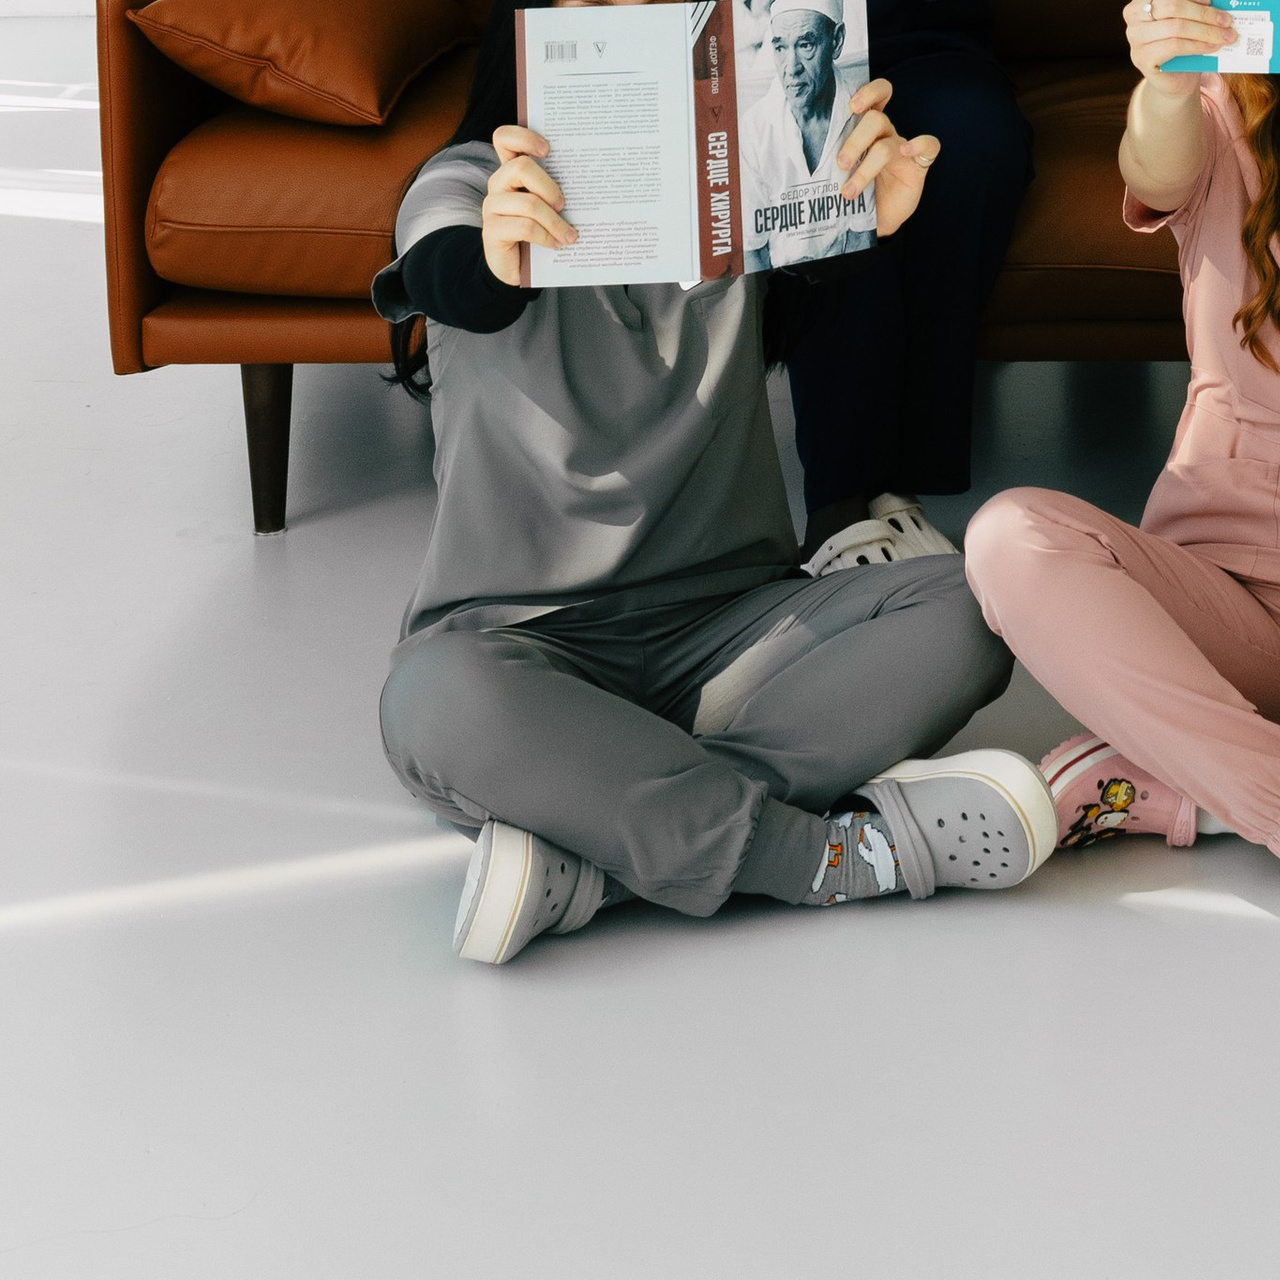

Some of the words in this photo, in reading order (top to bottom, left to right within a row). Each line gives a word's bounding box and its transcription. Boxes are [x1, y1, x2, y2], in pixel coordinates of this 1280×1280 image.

[709, 36, 718, 65] ФЕДОР
[711, 67, 719, 94] УГЛОВ
[706, 131, 729, 187] СЕРДЦЕ
[780, 188, 809, 202] ФЕДОР
[812, 183, 839, 195] УГЛОВ
[710, 192, 732, 257] ХИРУРГА
[755, 201, 805, 234] СЕРДЦЕ
[809, 192, 866, 224] ХИРУРГА
